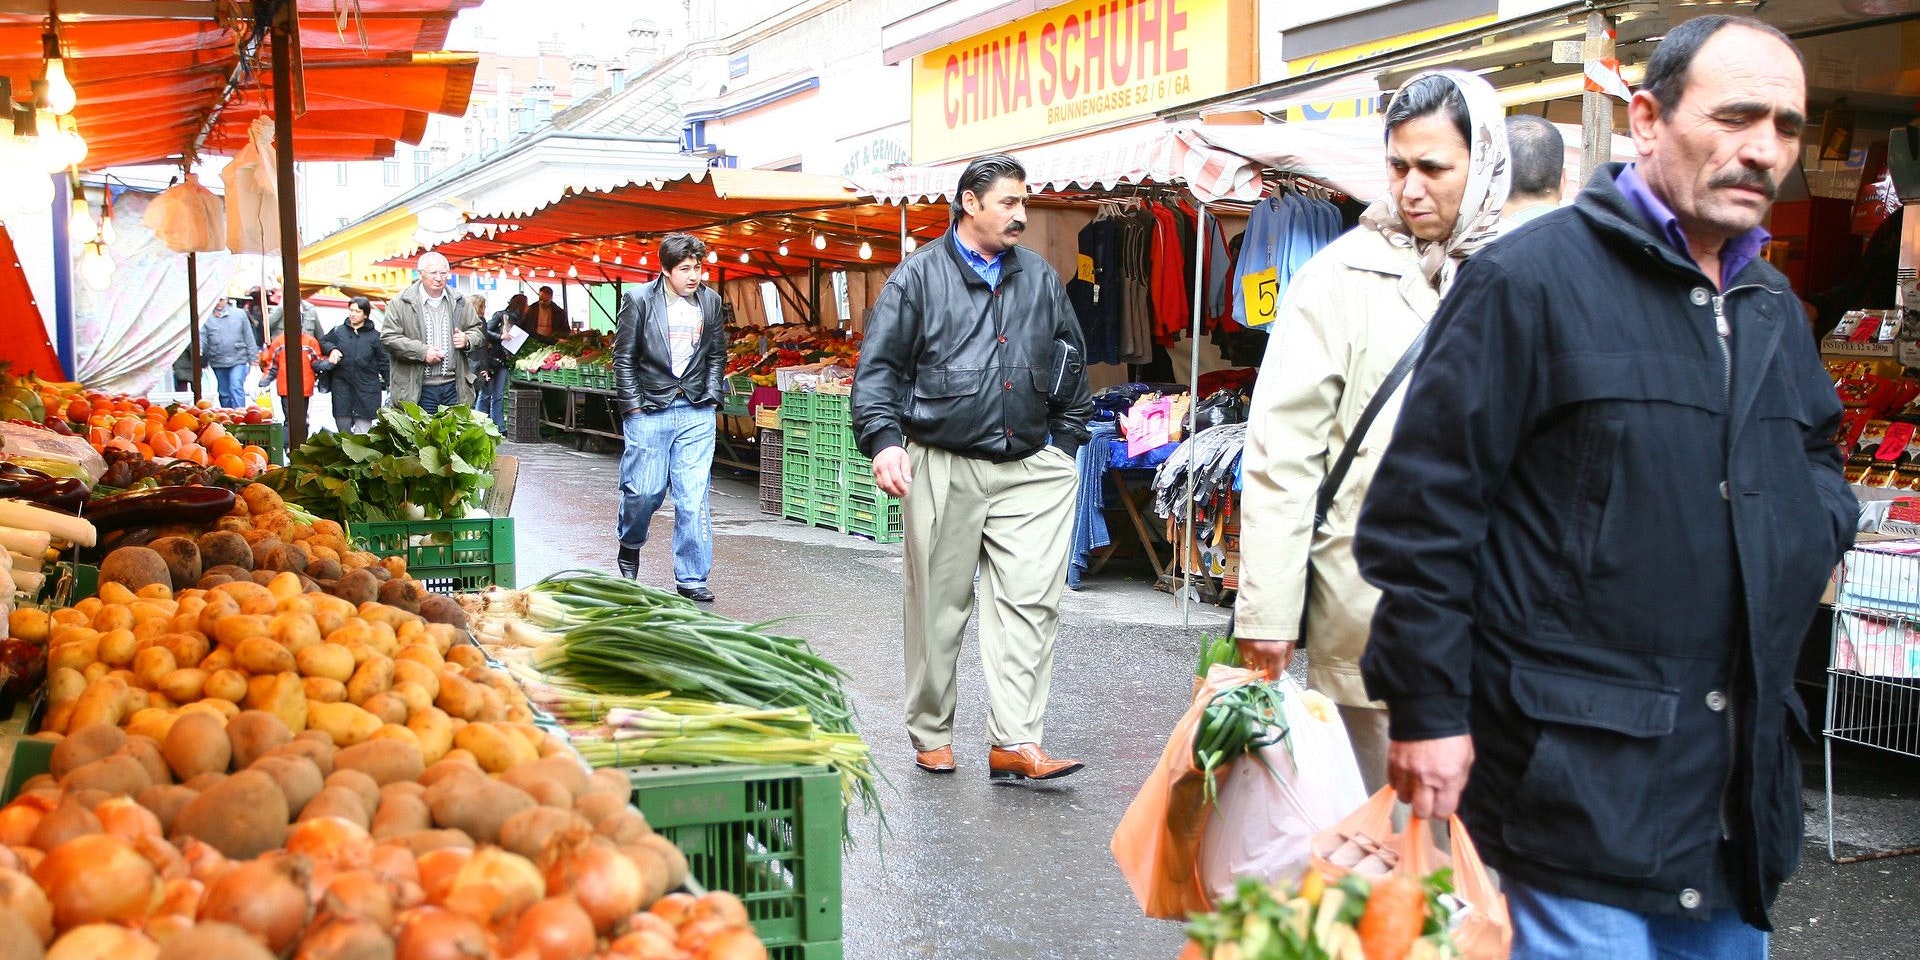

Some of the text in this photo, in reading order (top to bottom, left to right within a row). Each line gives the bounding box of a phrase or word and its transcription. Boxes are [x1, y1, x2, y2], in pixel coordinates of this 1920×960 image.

[944, 30, 1032, 129] CHINA
[1039, 0, 1188, 105] SCHUHE
[1047, 90, 1131, 124] BRUNNENGASSE
[1135, 85, 1148, 104] 52
[1157, 80, 1165, 98] 6
[1175, 75, 1190, 95] 6A
[863, 146, 870, 167] &
[873, 138, 907, 164] GEMÜS
